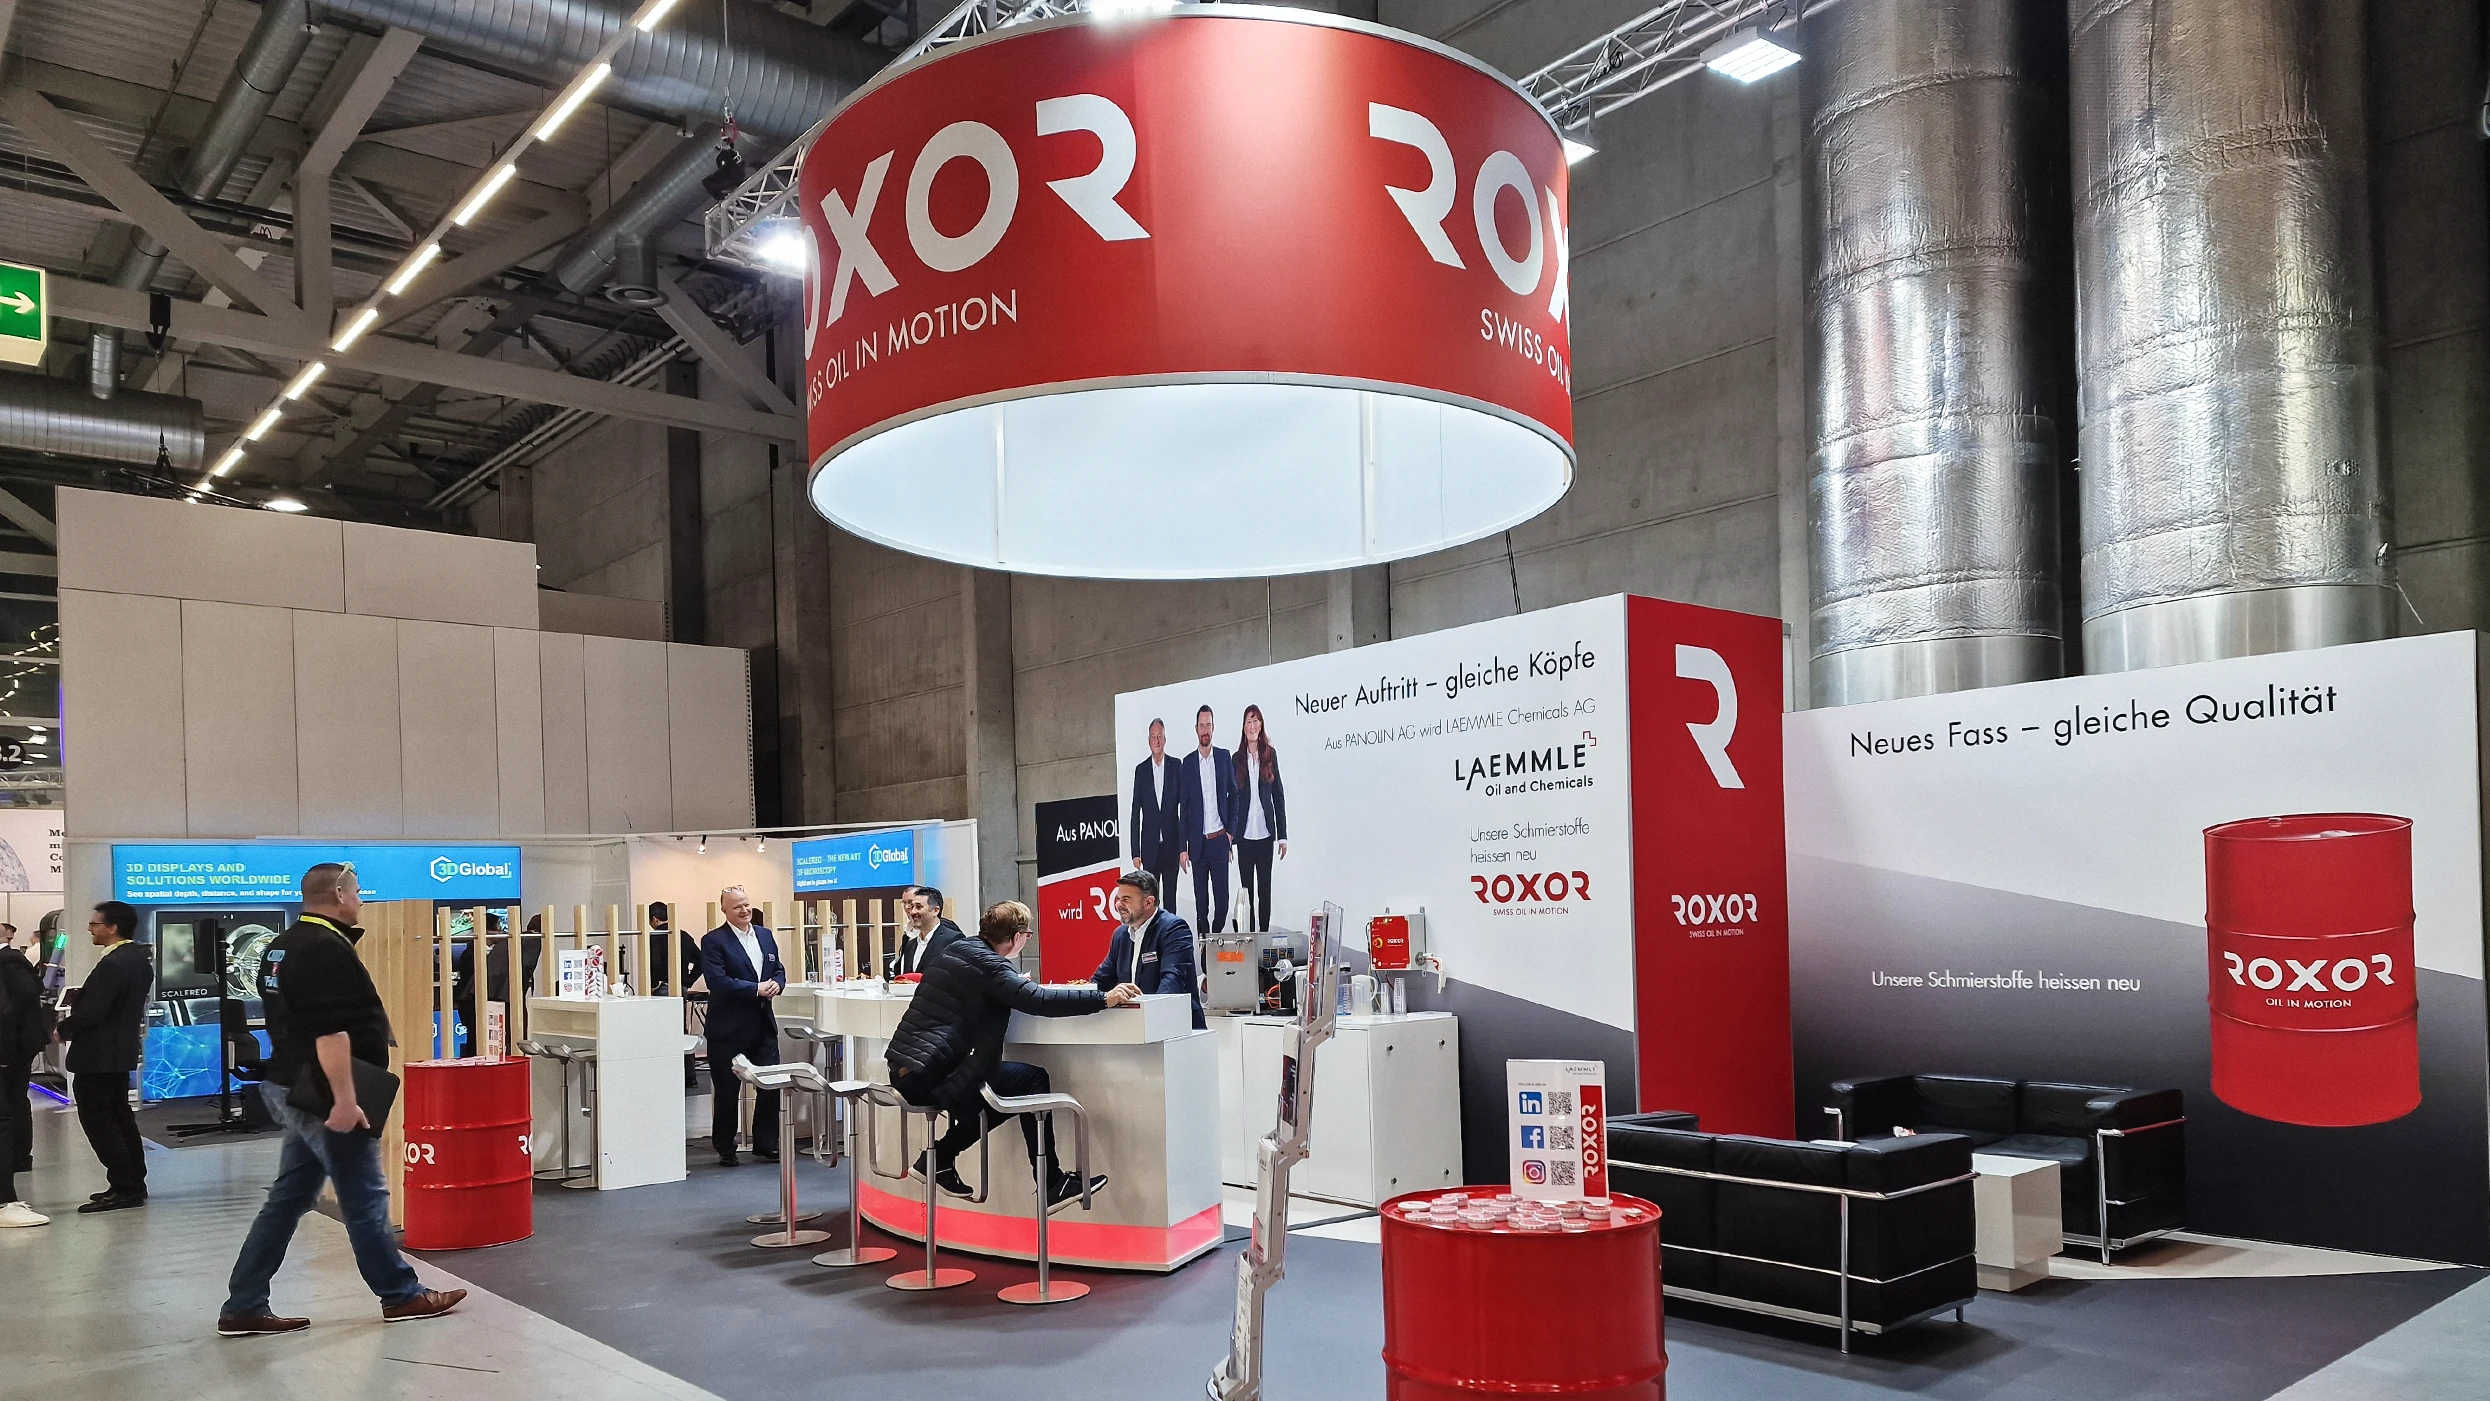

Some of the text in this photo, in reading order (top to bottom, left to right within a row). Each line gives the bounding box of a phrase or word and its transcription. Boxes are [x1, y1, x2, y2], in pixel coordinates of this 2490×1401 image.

[826, 349, 849, 389] OIL
[856, 331, 877, 370] IN
[888, 288, 1017, 356] MOTION
[1480, 308, 1543, 365] SWISS
[1548, 345, 1564, 386] OIL
[1295, 693, 1347, 716] Neuer
[1354, 676, 1418, 707] Auftritt
[1445, 656, 1519, 699] gleiche
[1529, 640, 1596, 681] Köpfe
[1324, 698, 1596, 751] Aus PANOLIN AG wird LAEMMLE Chemicals AG
[1675, 643, 1746, 789] R
[1850, 731, 1935, 758] Neues
[1948, 721, 2008, 748] Fass
[2053, 699, 2171, 746] gleiche
[2185, 684, 2338, 725] Qualität
[0, 745, 21, 762] .2
[1455, 744, 1587, 791] LAEMMLE
[1485, 775, 1594, 796] Oil and Chemicals
[1056, 824, 1077, 842] Aus
[1470, 817, 1590, 842] Unsere Schmierstoffe
[873, 847, 908, 864] 3DGlobal
[1470, 848, 1537, 863] heissen neu
[126, 863, 246, 873] 3D DISPLAYS AND
[438, 862, 509, 876] 3DGlobal
[126, 875, 291, 885] SOLUTIONS WORLDWIDE
[1470, 870, 1592, 903] ROXOR
[127, 890, 143, 898] See
[145, 890, 172, 899] spatial
[256, 889, 279, 897] shape
[281, 888, 292, 896] for
[1058, 900, 1083, 920] wird
[1493, 908, 1514, 916] SWISS
[1539, 907, 1569, 915] MOTION
[1671, 893, 1758, 925] ROXOR
[1689, 930, 1706, 938] SWISS
[1723, 928, 1744, 936] MOTION
[1871, 969, 2141, 992] Unsere Schmierstoffe heissen neu
[2223, 951, 2395, 992] ROXOR
[2266, 998, 2352, 1009] OIL IN MOTION
[1581, 1104, 1600, 1178] ROXOR
